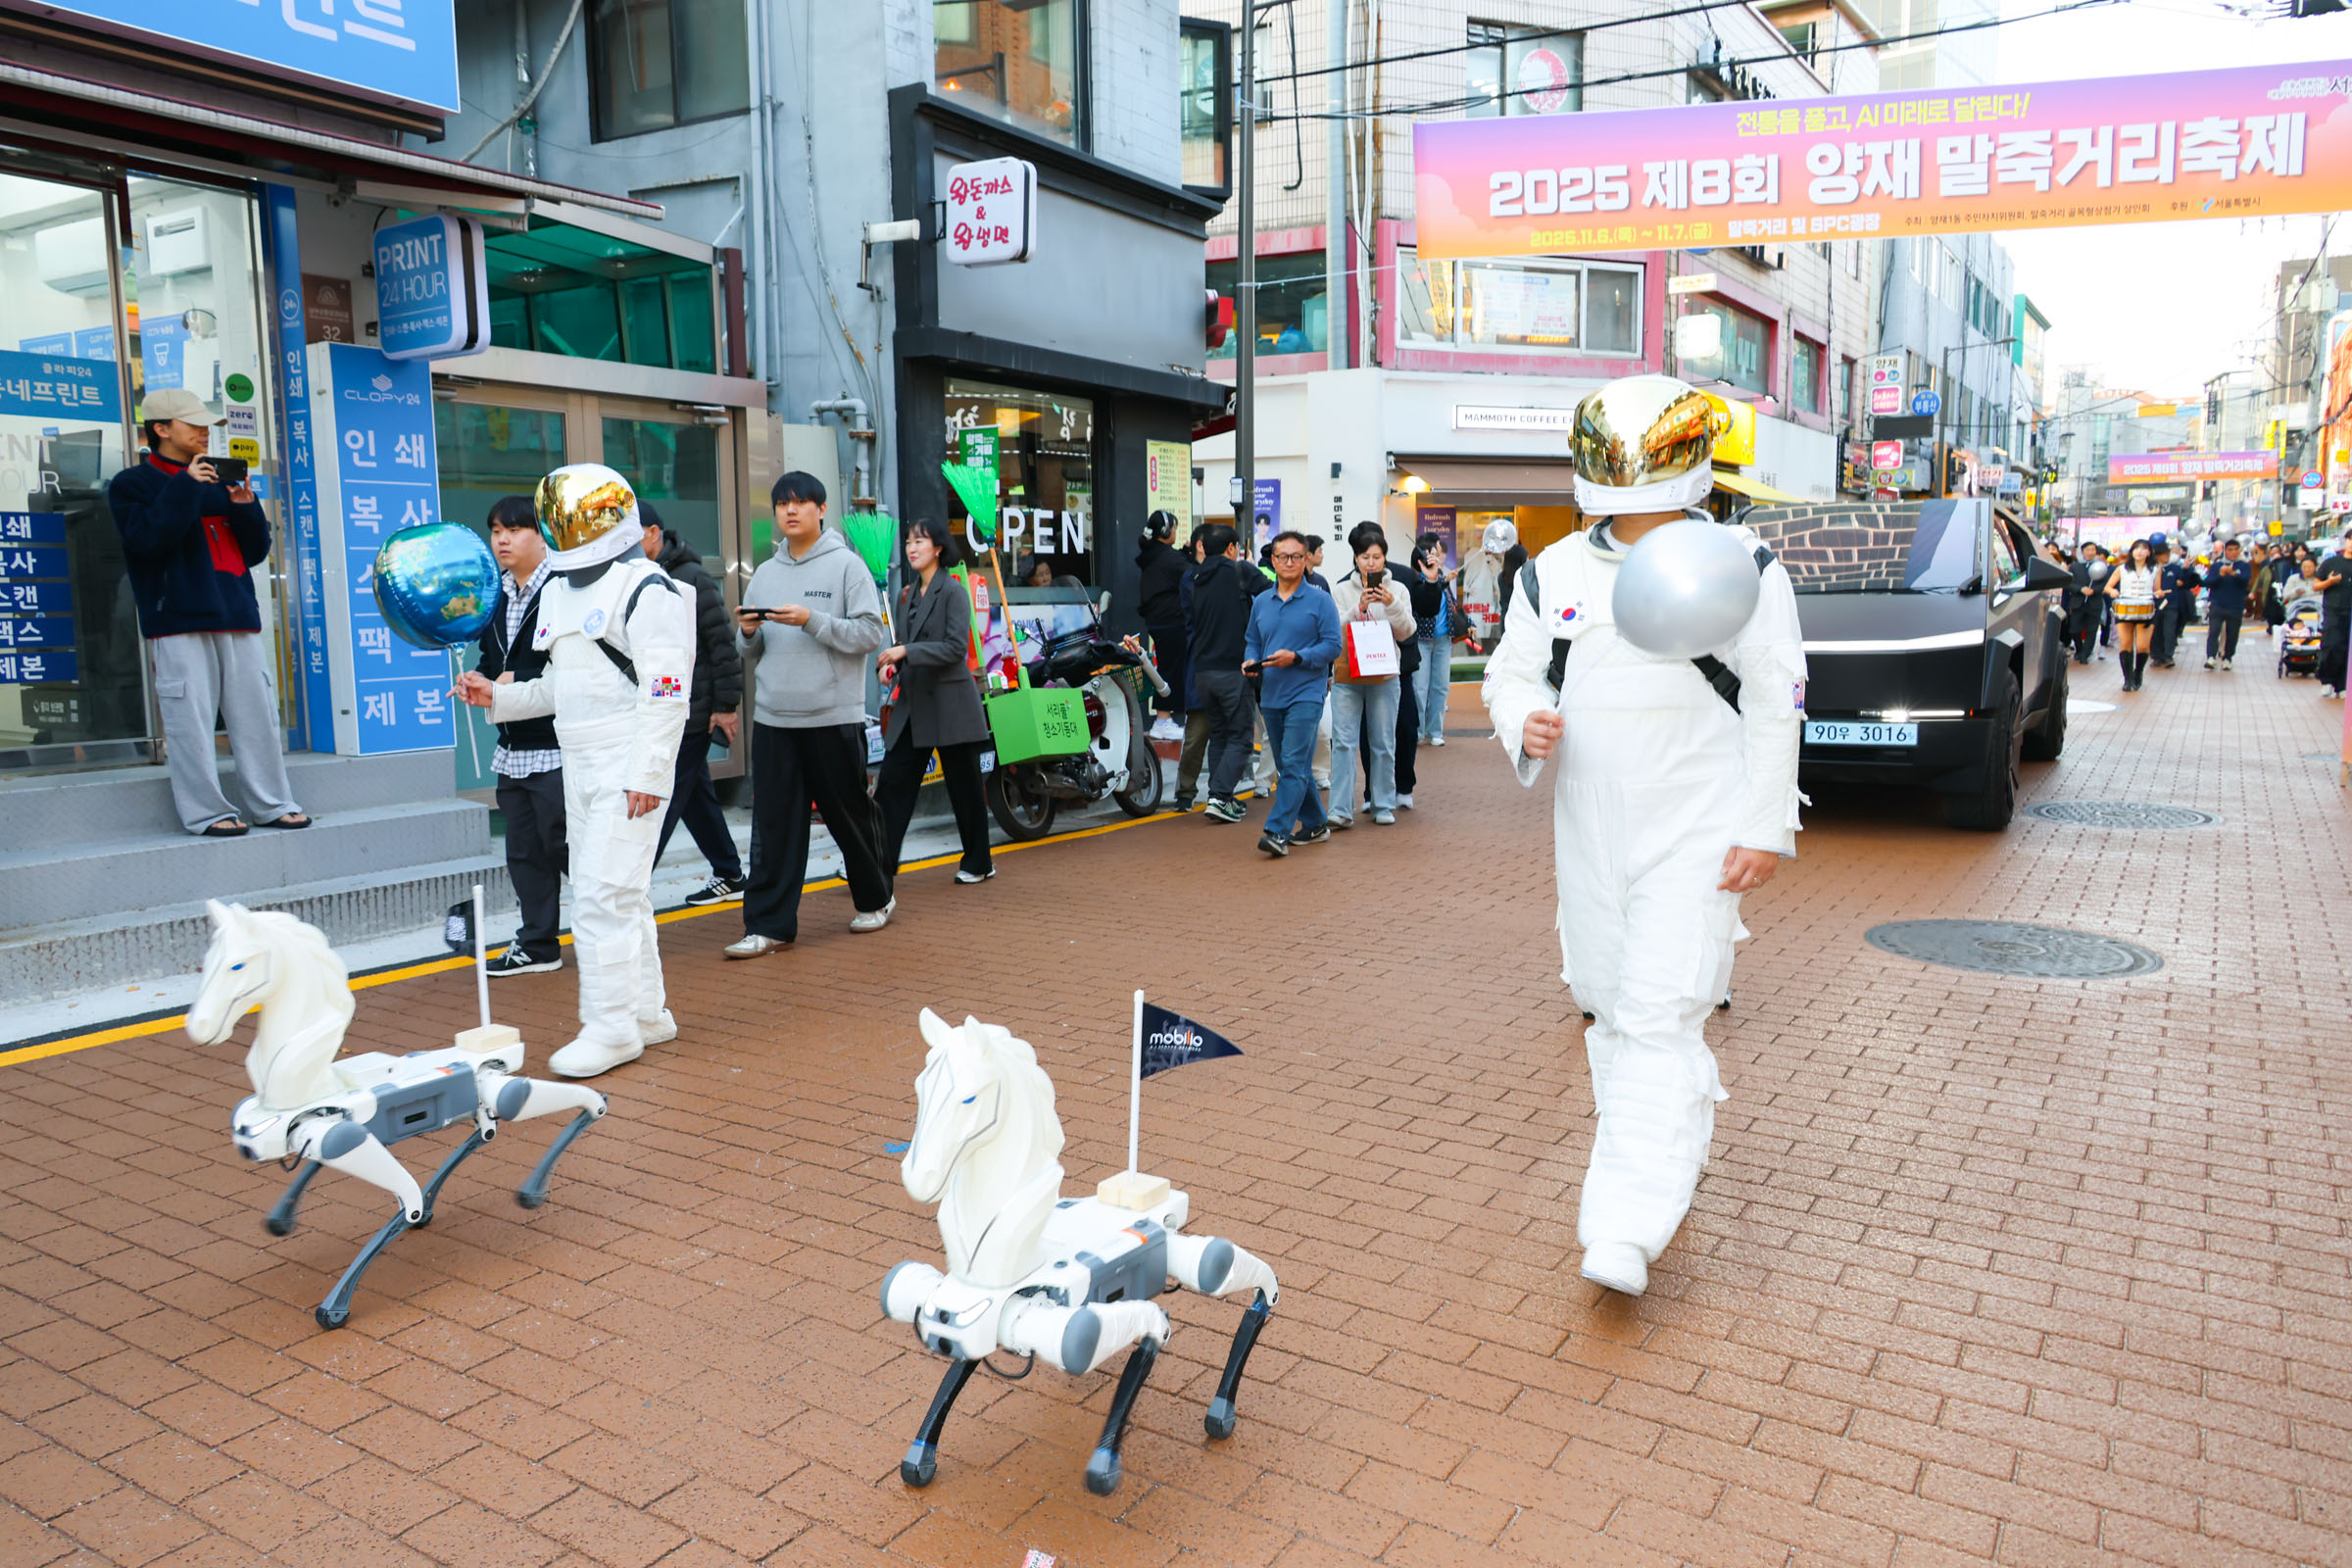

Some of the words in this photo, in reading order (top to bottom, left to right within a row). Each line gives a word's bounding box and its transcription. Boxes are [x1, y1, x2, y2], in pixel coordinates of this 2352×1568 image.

[1737, 109, 1801, 136] 전통을
[1856, 104, 1880, 127] AI
[1884, 99, 1949, 126] 미래로
[1954, 92, 2032, 123] 달린다!
[1489, 164, 1630, 217] 2025
[1641, 153, 1779, 210] 제8회
[1806, 138, 1921, 205] 양재
[1936, 112, 2305, 197] 말죽거리축제
[950, 174, 1013, 205] 왕돈까스
[976, 206, 987, 220] &
[1728, 218, 1788, 238] 말죽거리
[1791, 217, 1806, 233] 및
[1811, 212, 1881, 233] SPC광장
[378, 234, 442, 275] PRINT
[380, 280, 400, 308] 24
[403, 271, 447, 302] HOUR
[322, 324, 342, 341] 32
[287, 350, 304, 398] 인쇄
[1464, 413, 1517, 423] MAMMOTH
[1520, 415, 1558, 424] COFFEE
[1915, 399, 1938, 414] 부동산
[293, 419, 310, 467] 복사
[0, 514, 32, 539] 쇄
[298, 491, 315, 538] 스캔
[303, 558, 319, 603] 팩스
[804, 590, 832, 599] MASTER
[308, 626, 324, 673] 제본
[1047, 703, 1067, 719] 서리풀
[1043, 721, 1078, 739] 청소기동대
[1859, 726, 1908, 742] 3016
